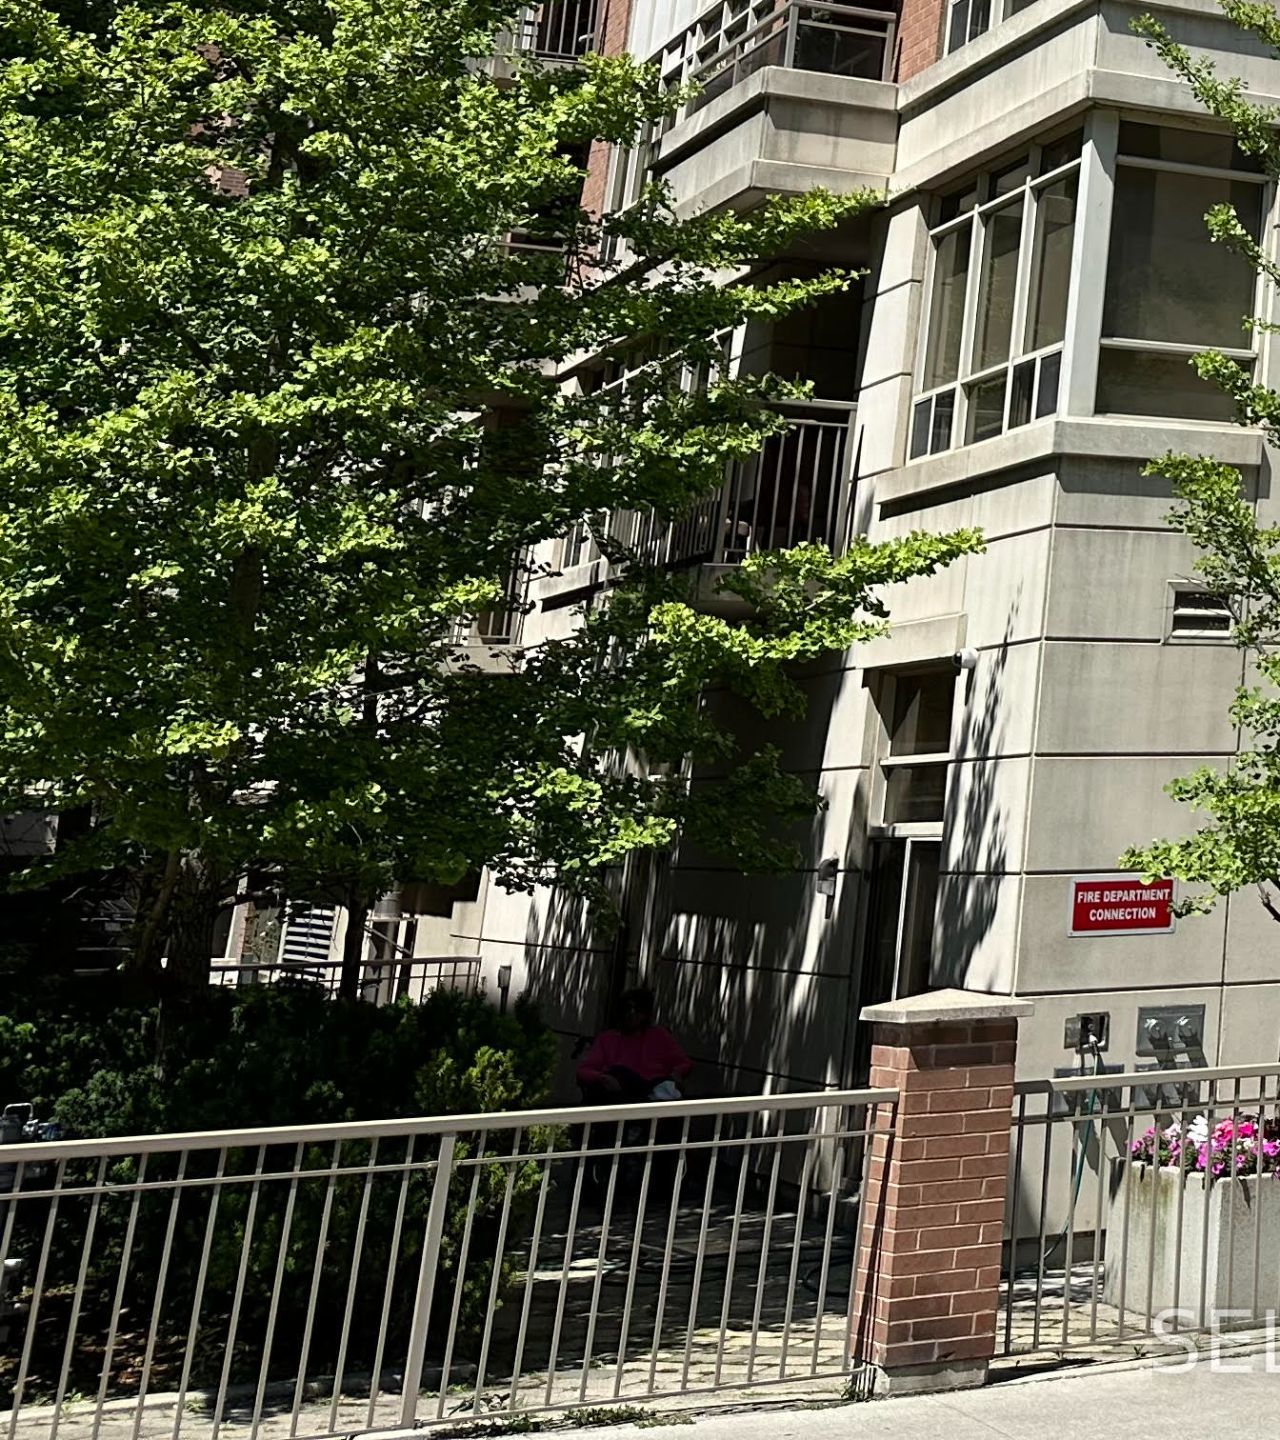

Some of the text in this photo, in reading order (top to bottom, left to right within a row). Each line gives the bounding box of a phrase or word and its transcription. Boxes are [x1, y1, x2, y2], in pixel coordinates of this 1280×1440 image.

[1077, 888, 1171, 903] FIRE DEPARTMENT
[1089, 907, 1157, 921] CONNECTION
